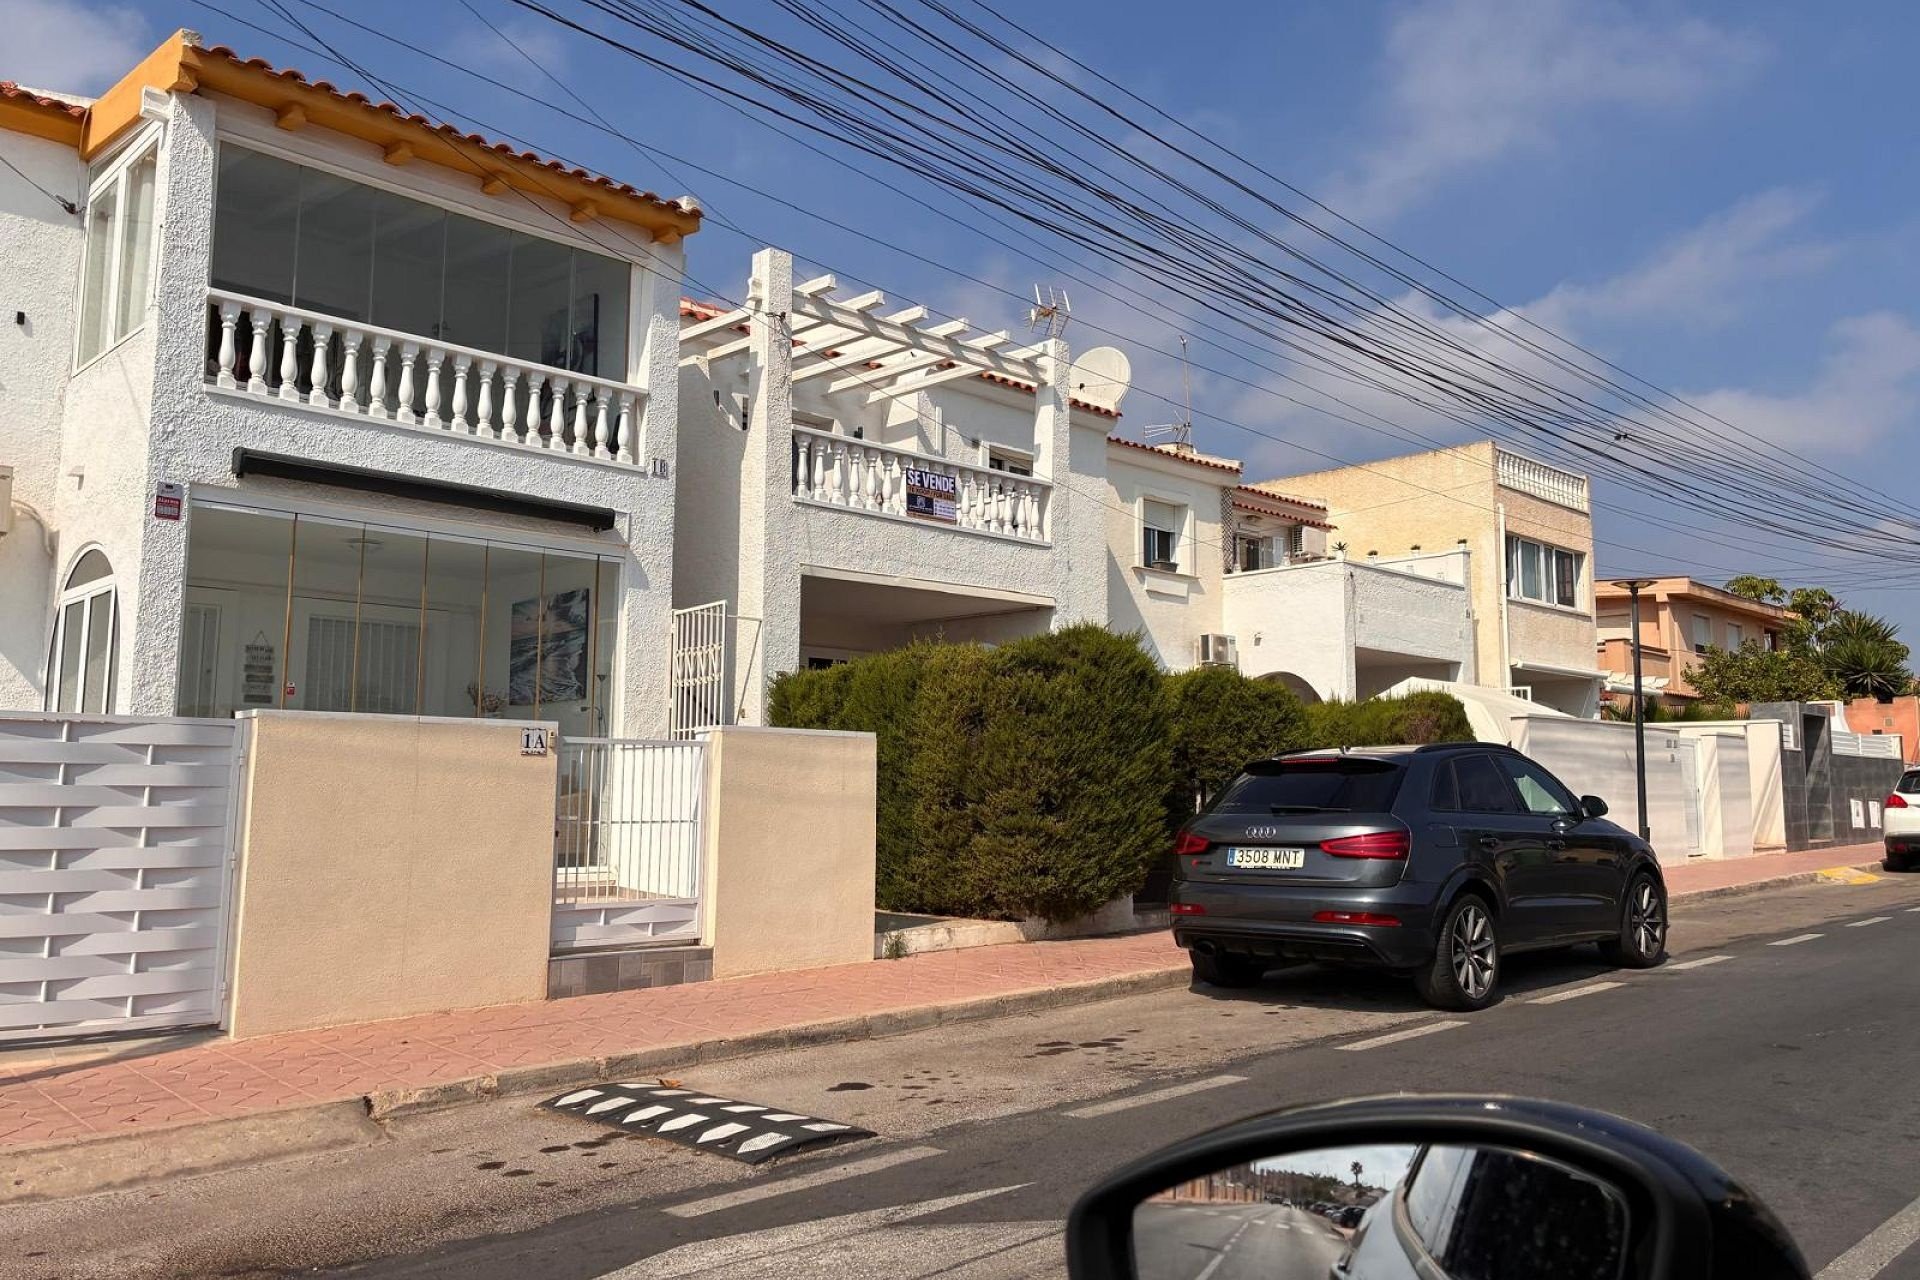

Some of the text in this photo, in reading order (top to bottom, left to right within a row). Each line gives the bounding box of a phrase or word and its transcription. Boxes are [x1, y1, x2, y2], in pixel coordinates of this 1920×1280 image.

[907, 470, 955, 494] SE VENDE
[524, 733, 545, 748] 1A
[1237, 849, 1300, 865] 3508 MNT
